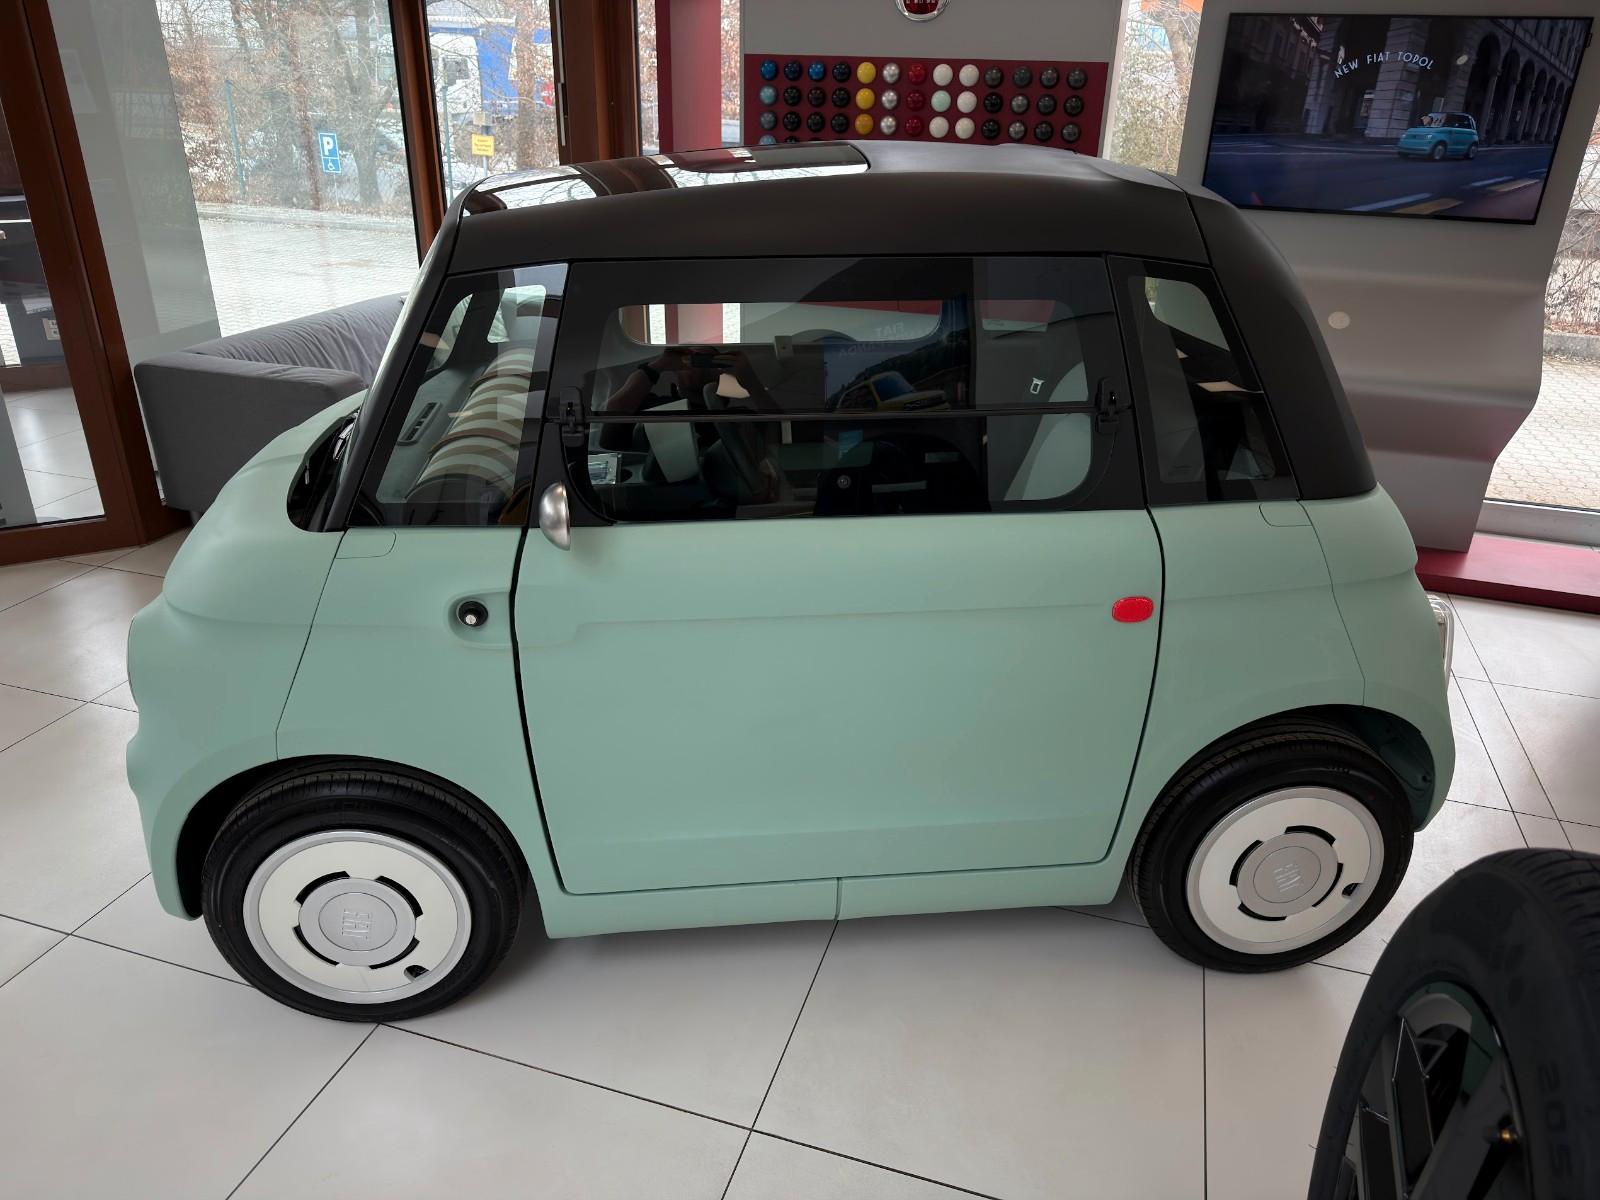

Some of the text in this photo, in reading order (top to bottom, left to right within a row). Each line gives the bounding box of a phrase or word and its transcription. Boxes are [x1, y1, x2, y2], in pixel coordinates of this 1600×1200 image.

[1334, 51, 1434, 79] NEW FIAT TOPOL
[322, 135, 334, 156] P
[1537, 1060, 1574, 1200] 205
